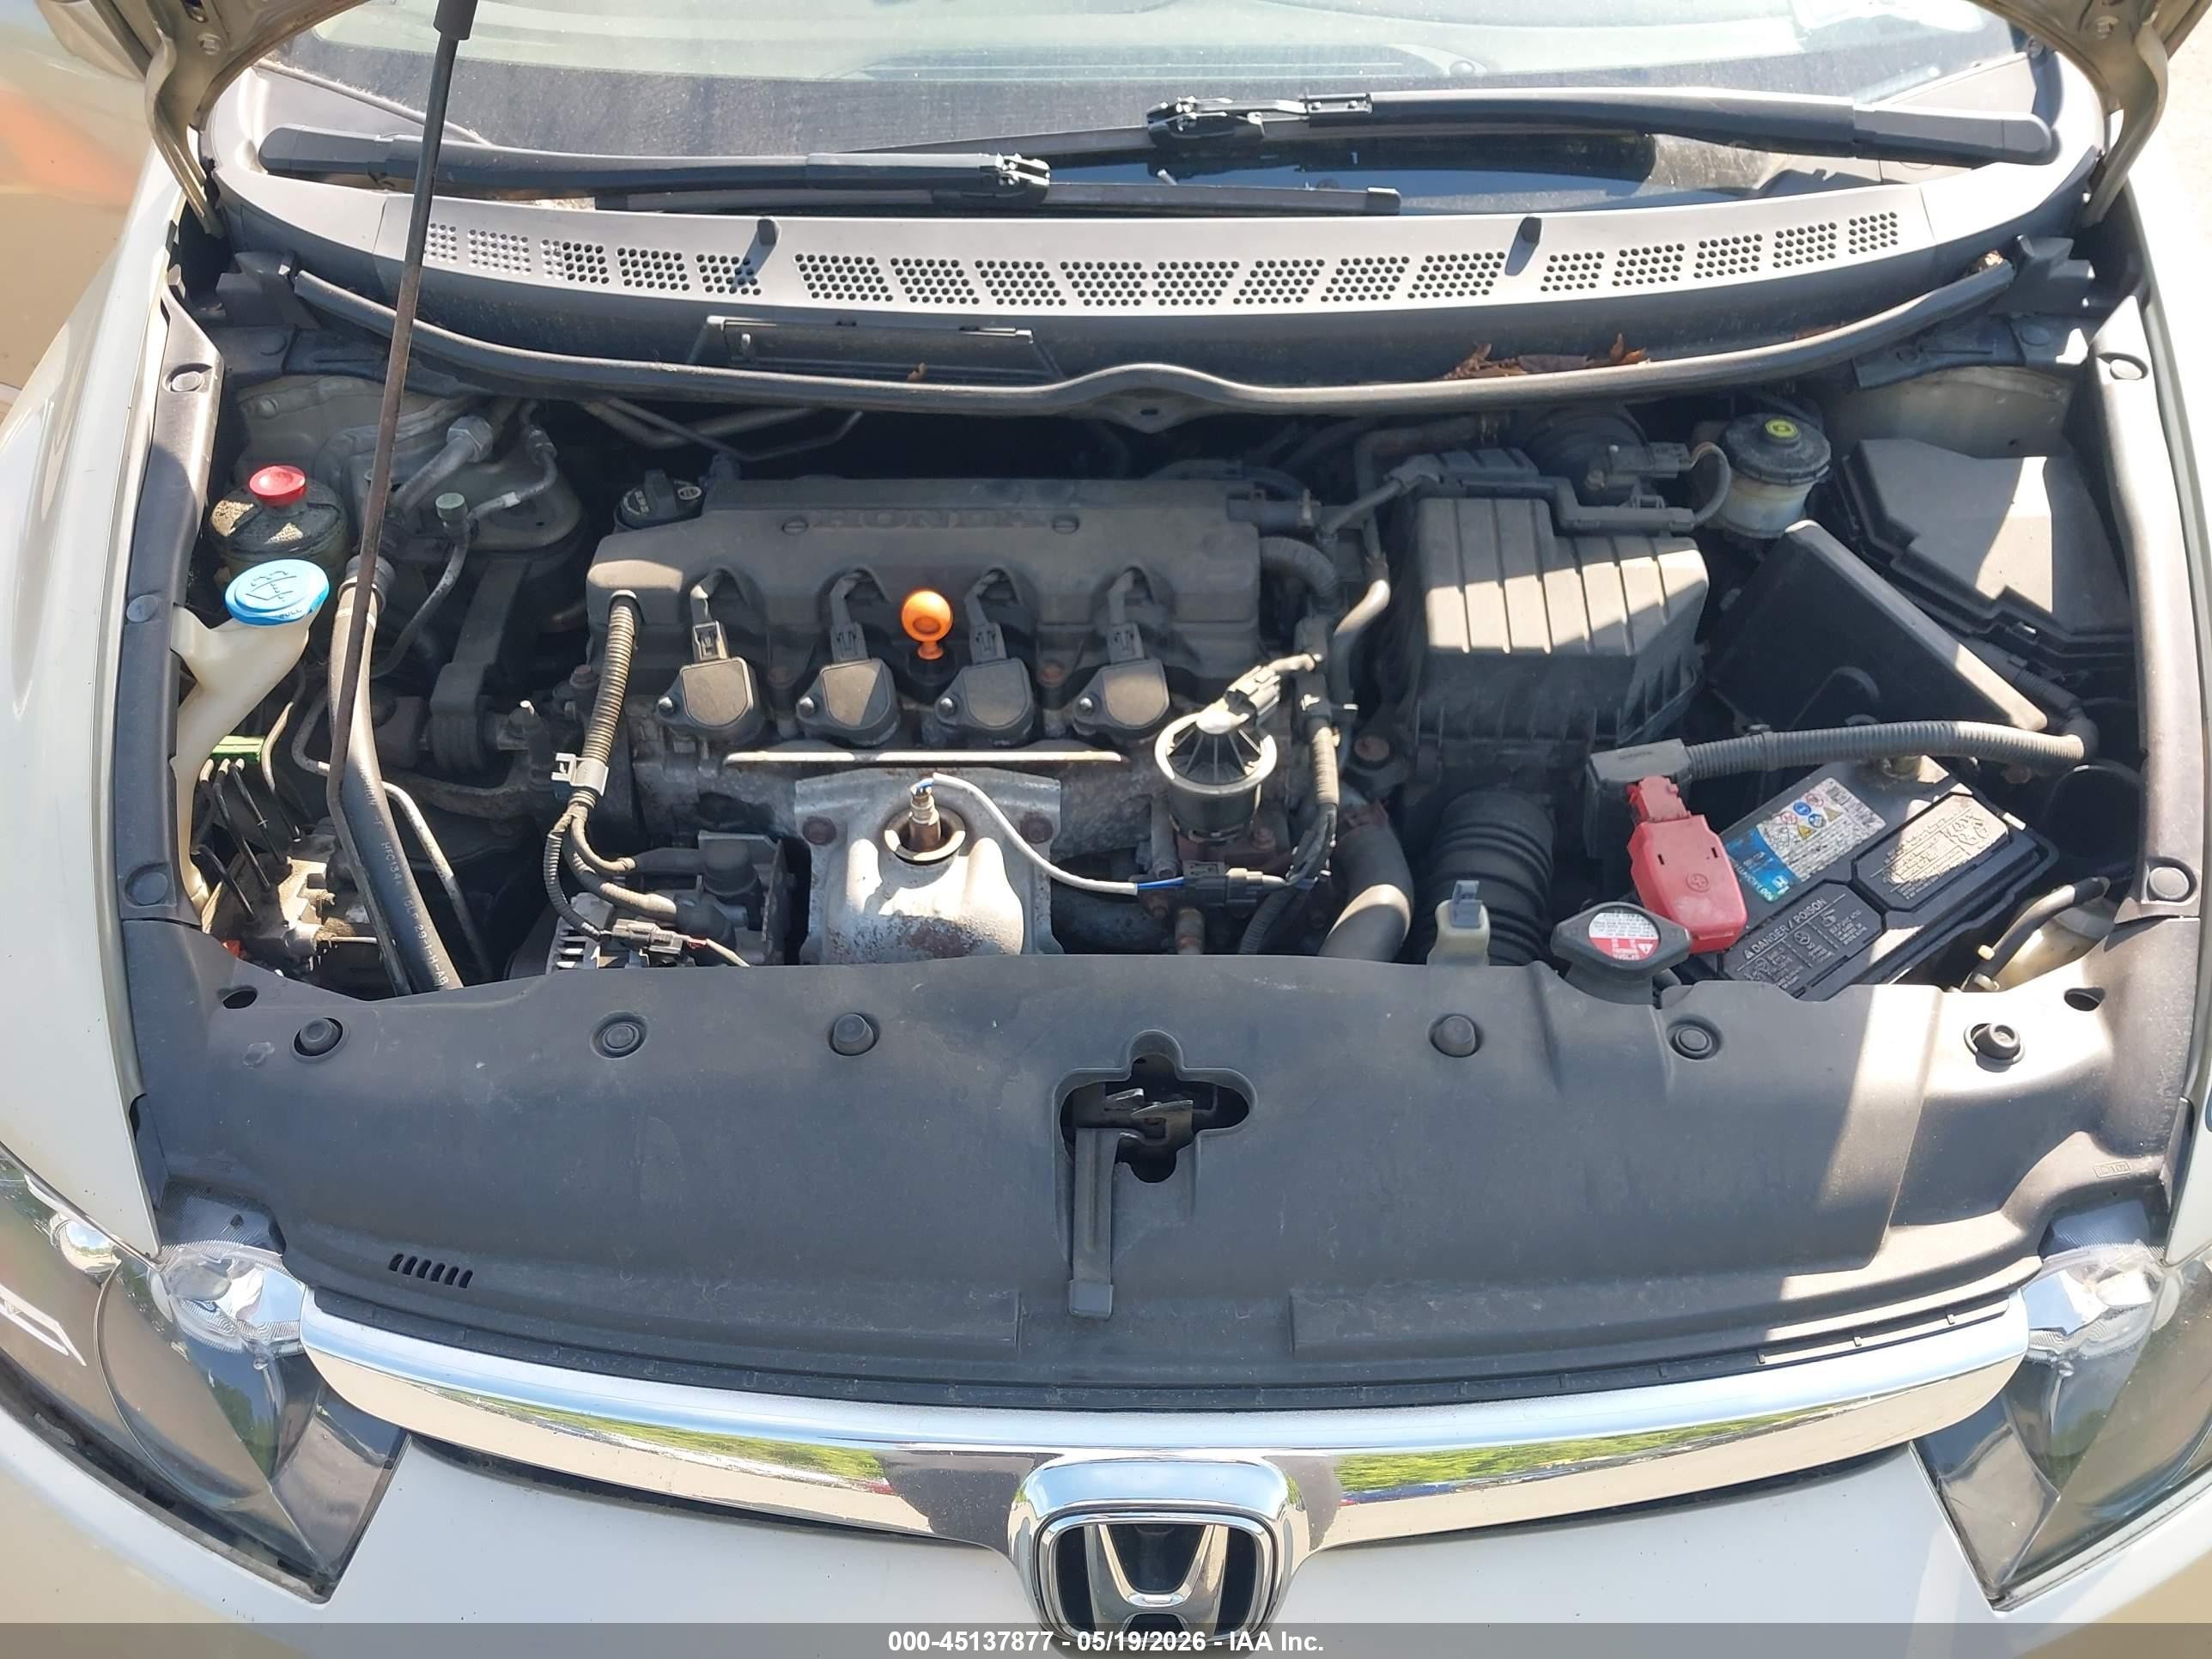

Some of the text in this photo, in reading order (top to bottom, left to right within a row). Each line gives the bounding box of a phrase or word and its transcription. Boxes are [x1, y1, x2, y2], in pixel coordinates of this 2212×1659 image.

[811, 508, 1047, 529] HONDA
[278, 609, 303, 619] PULL
[1751, 925, 1790, 954] DANGER
[1793, 897, 1828, 924] POISON
